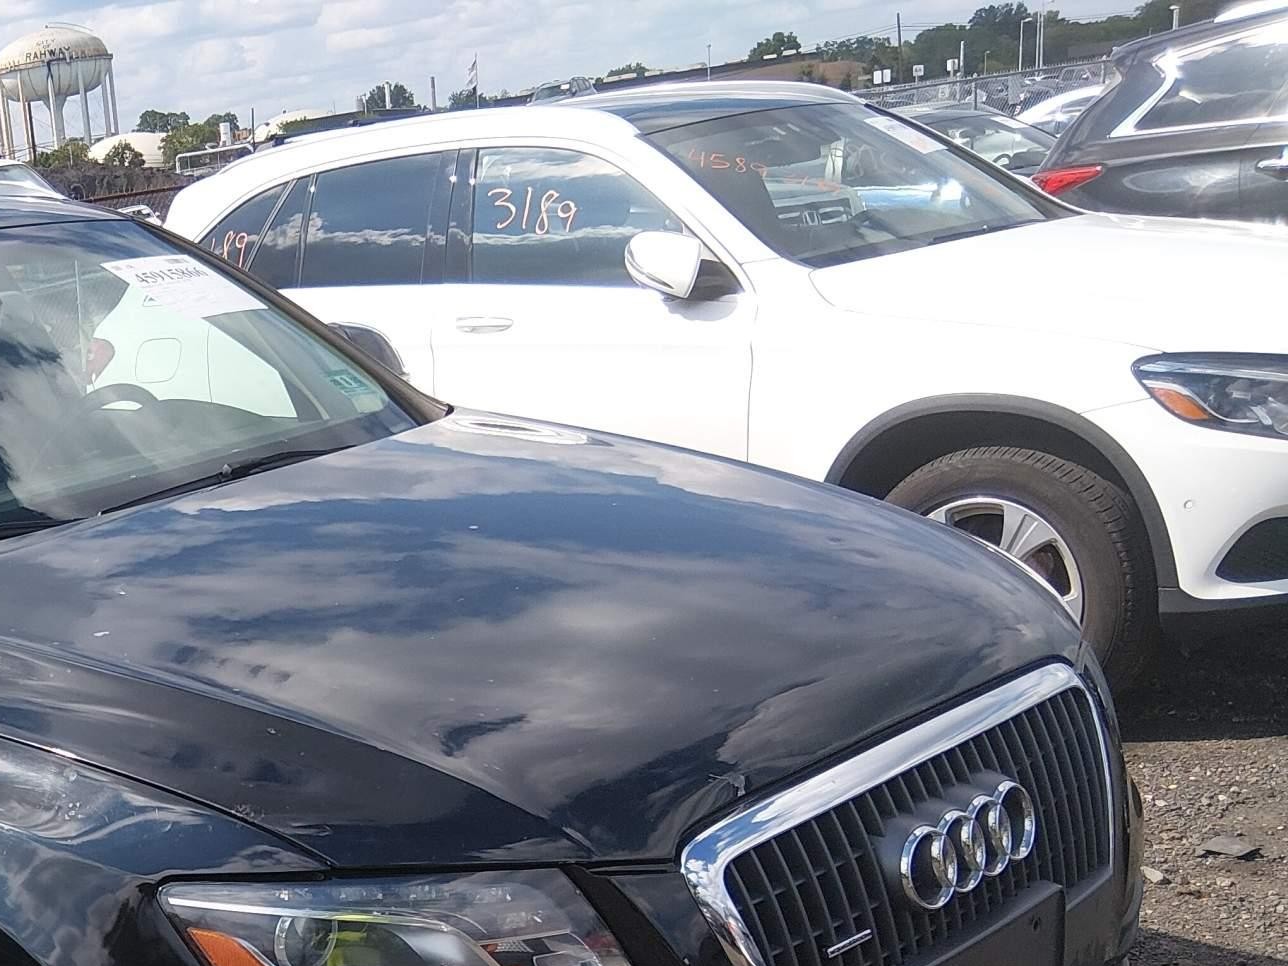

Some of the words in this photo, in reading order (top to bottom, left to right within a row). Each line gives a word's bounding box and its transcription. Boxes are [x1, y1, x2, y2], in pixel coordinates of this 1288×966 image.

[25, 46, 71, 61] RAHWAY
[487, 186, 578, 235] 3189
[134, 266, 209, 286] 45915866
